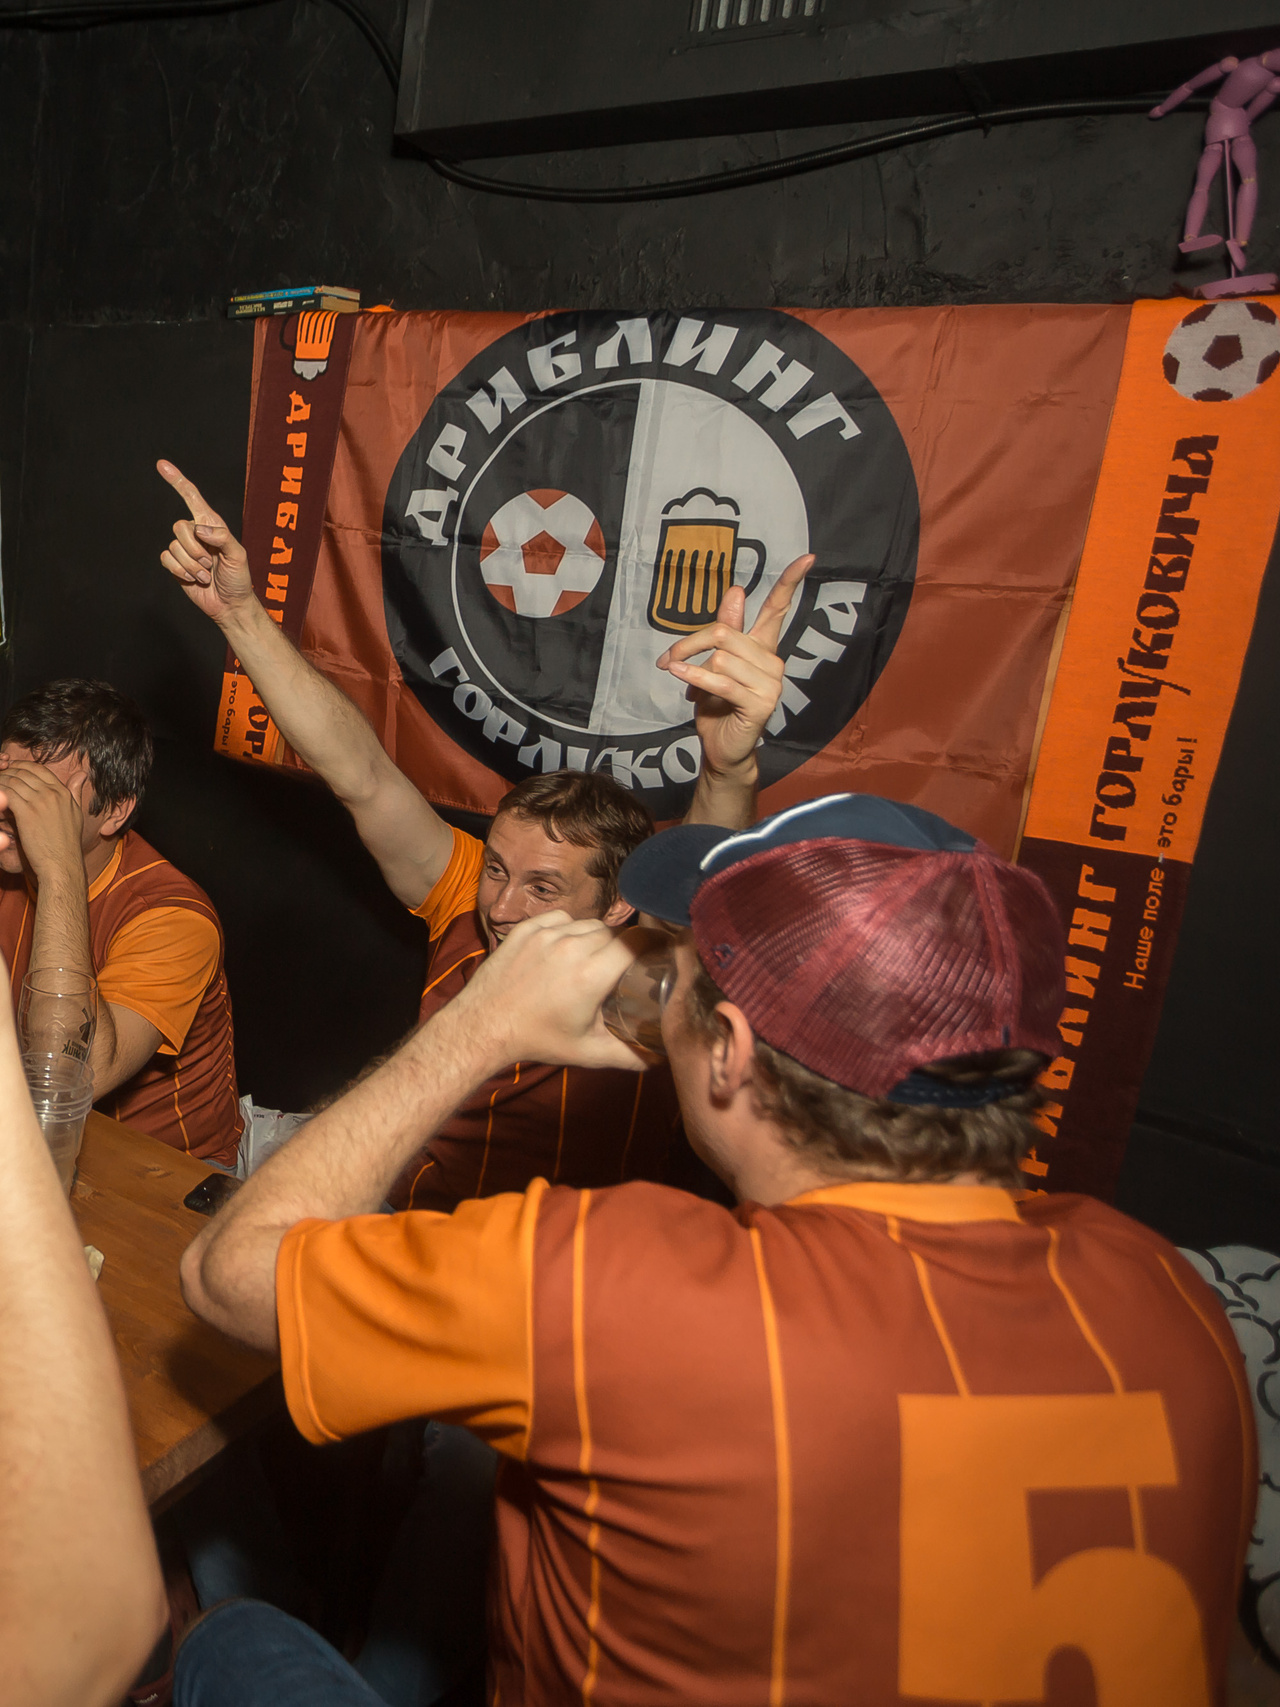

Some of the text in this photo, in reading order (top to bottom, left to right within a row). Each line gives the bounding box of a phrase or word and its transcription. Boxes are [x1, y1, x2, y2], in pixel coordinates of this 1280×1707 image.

[404, 315, 863, 546] ДРИБЛИНГ
[429, 580, 868, 789] ГОРЛУКОИЧА
[1088, 434, 1220, 841] ГОРЛУКОВИЧА
[1123, 925, 1154, 990] Наше
[1143, 867, 1165, 922] поле
[1157, 811, 1178, 848] это
[897, 1391, 1211, 1707] 5
